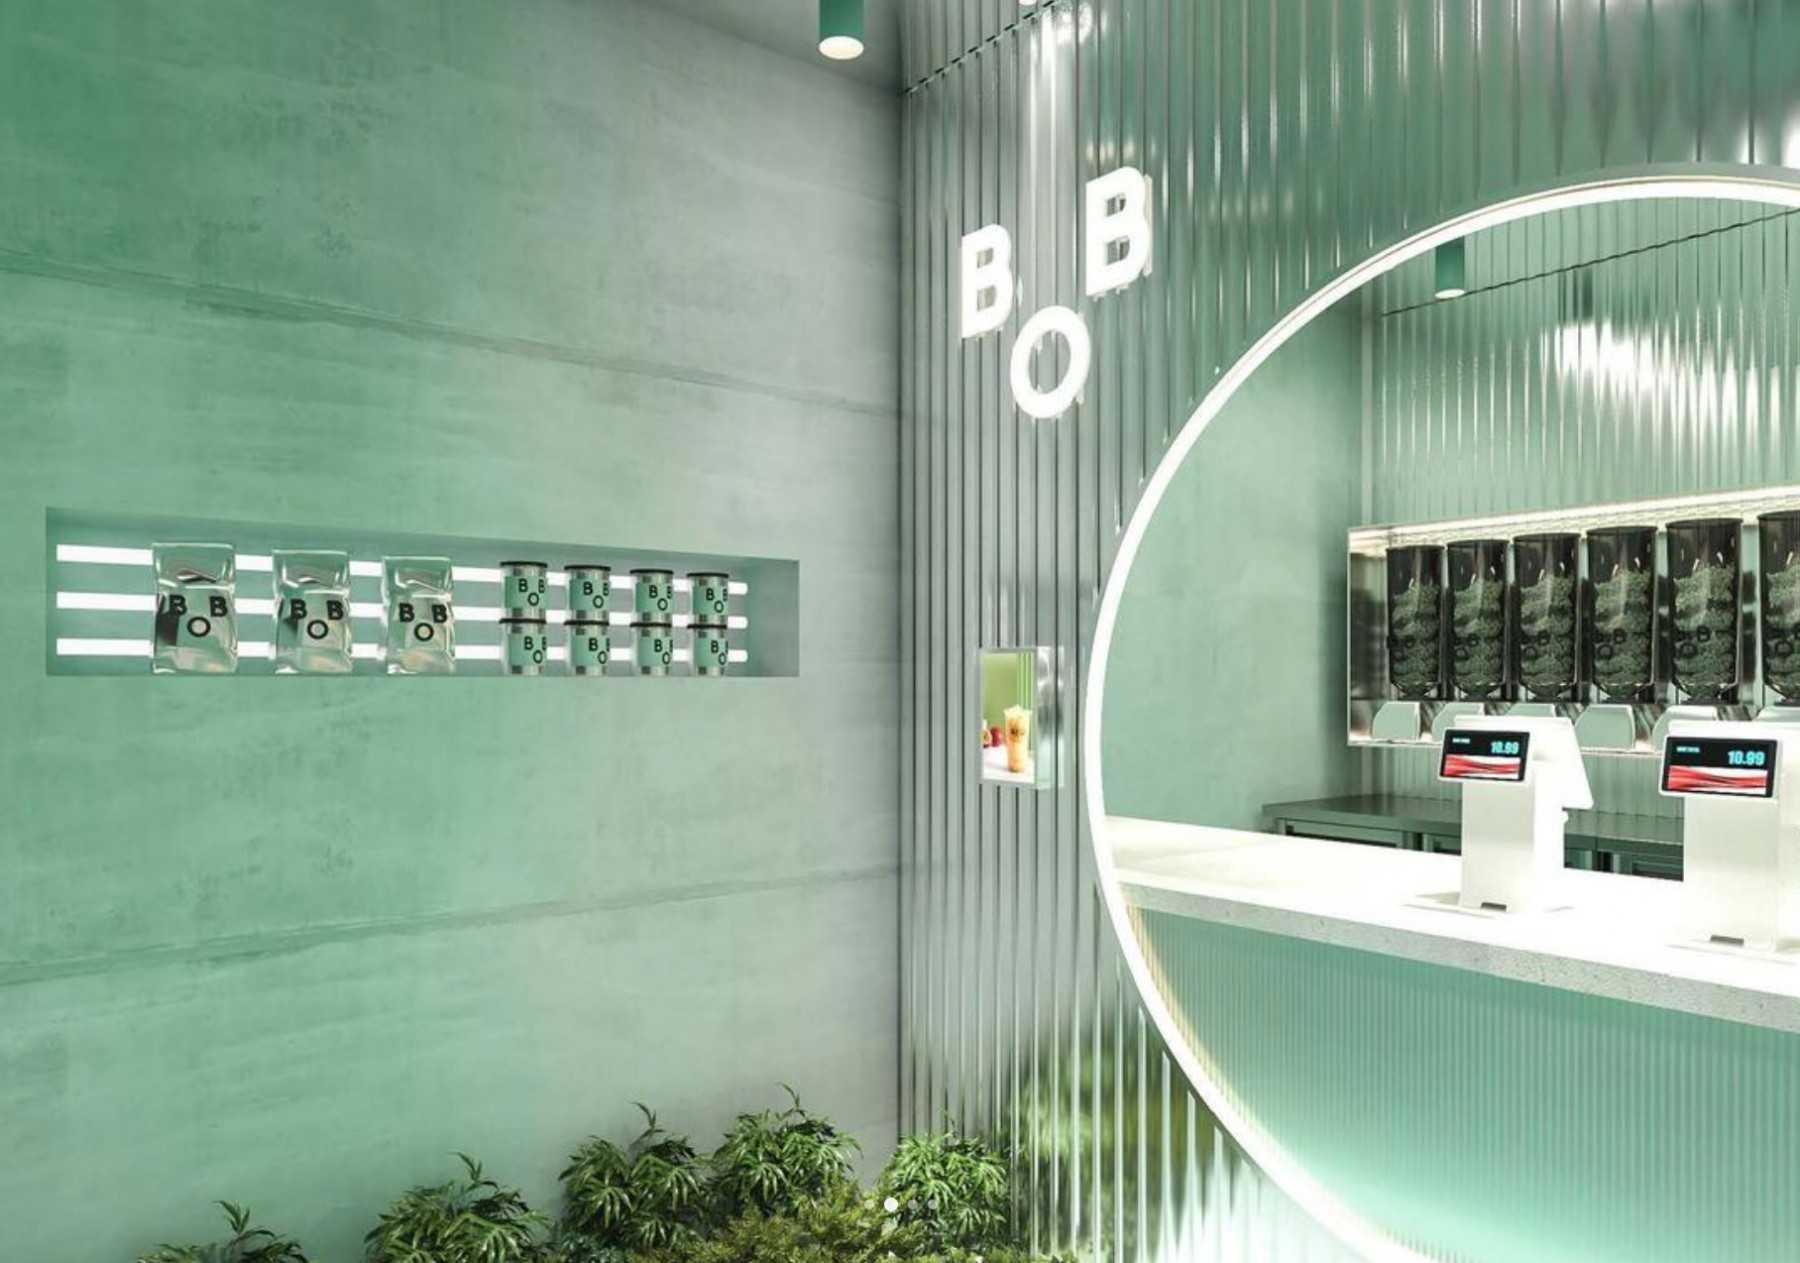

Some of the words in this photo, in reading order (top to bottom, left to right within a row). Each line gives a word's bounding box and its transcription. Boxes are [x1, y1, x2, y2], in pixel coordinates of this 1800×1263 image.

[961, 166, 1151, 418] BOB
[169, 594, 228, 638] BOB
[290, 598, 344, 640] BOB
[399, 602, 448, 642] BOB
[711, 640, 729, 665] BO
